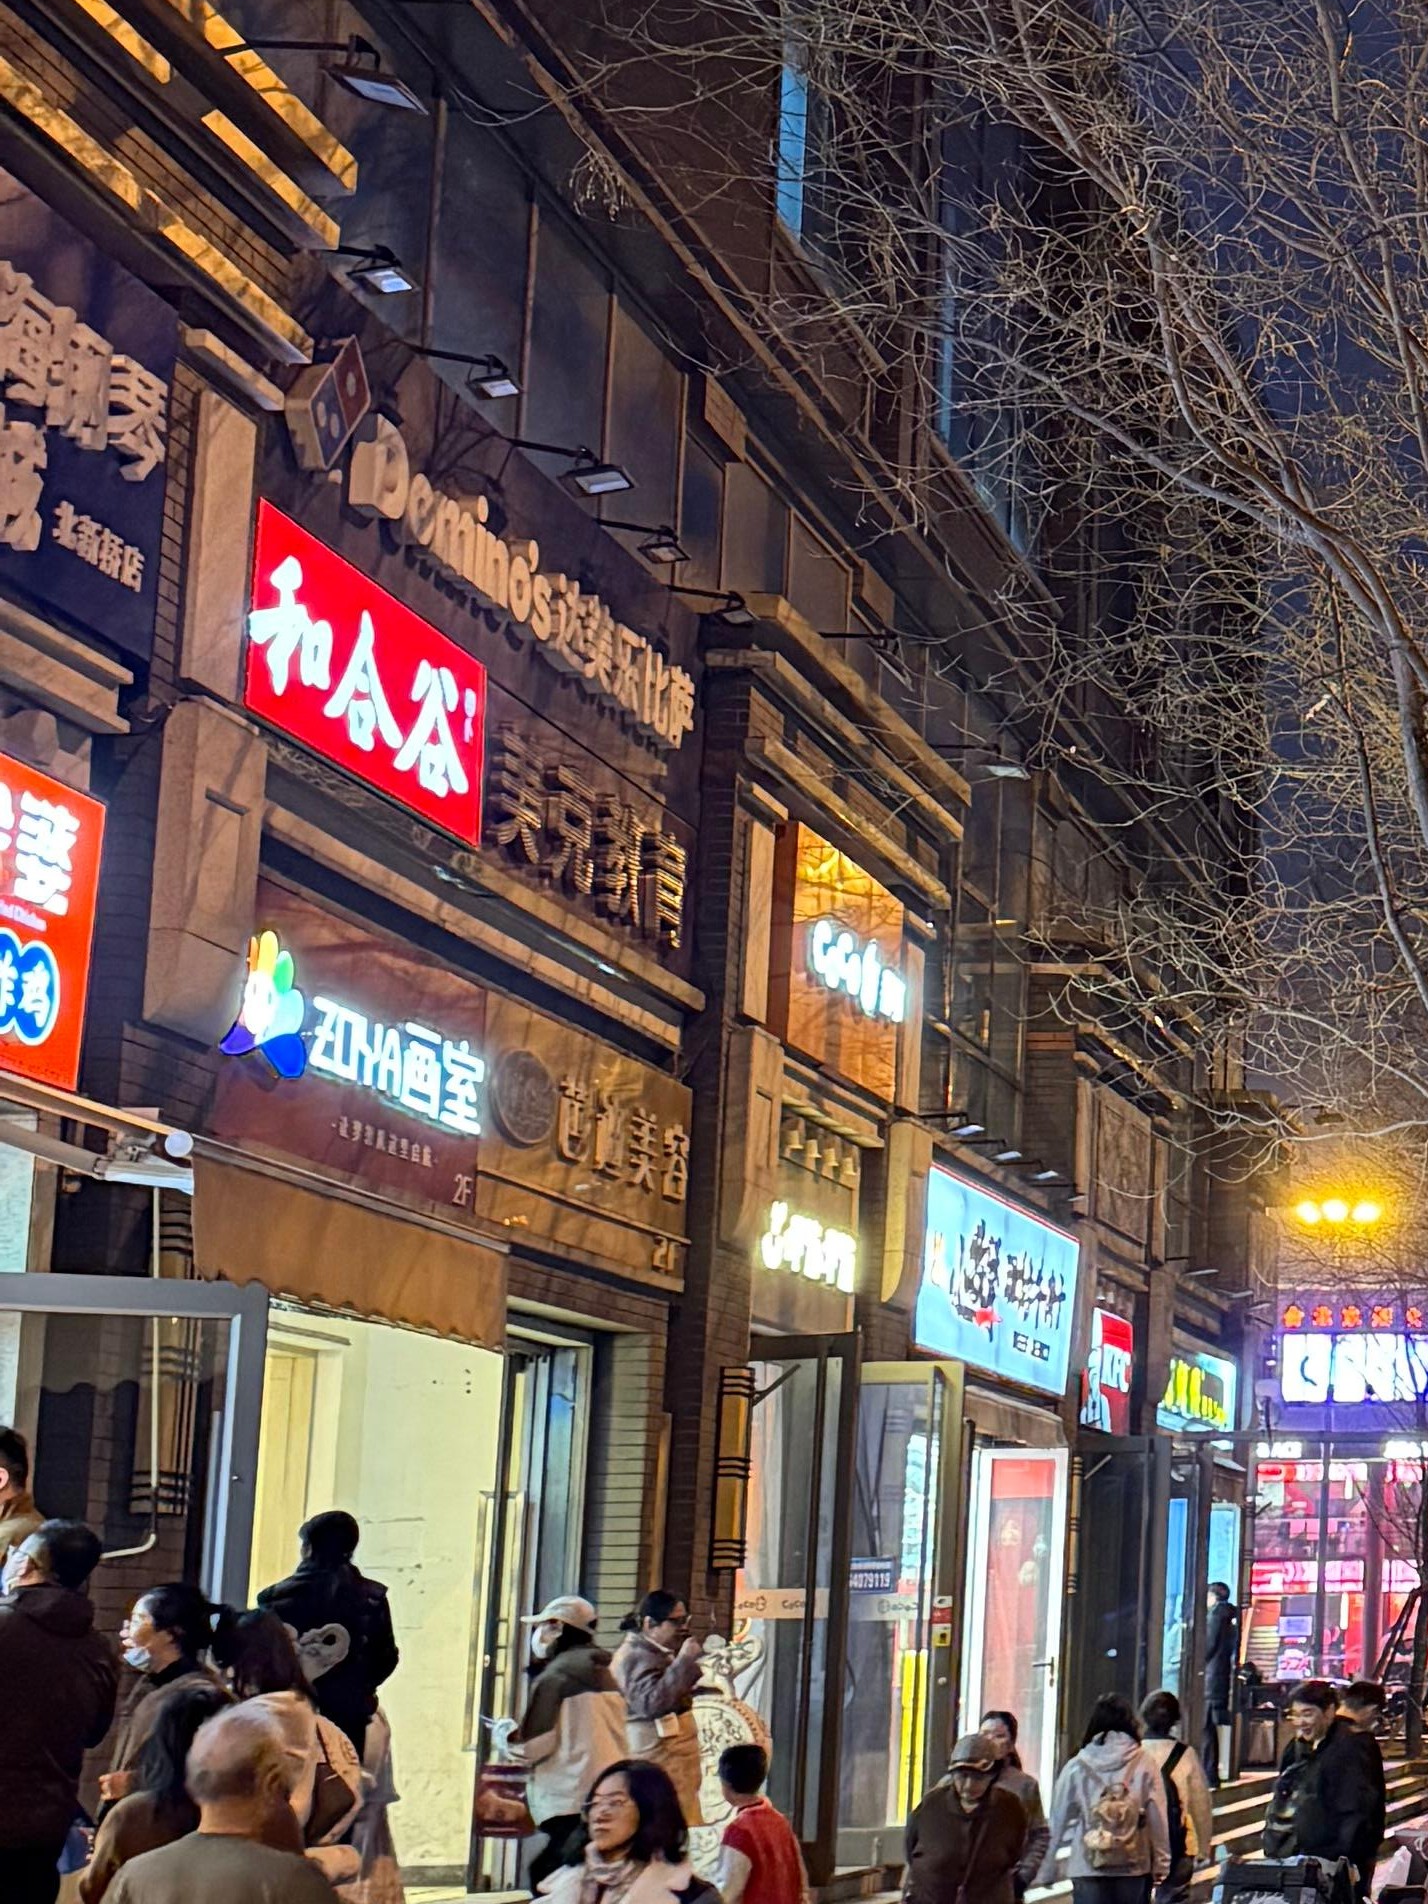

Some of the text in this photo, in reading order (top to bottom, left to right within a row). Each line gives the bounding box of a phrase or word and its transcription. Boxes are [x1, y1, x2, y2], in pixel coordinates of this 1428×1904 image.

[52, 500, 144, 593] 北新桥店
[247, 555, 468, 798] 和合谷
[452, 1172, 473, 1206] 2F
